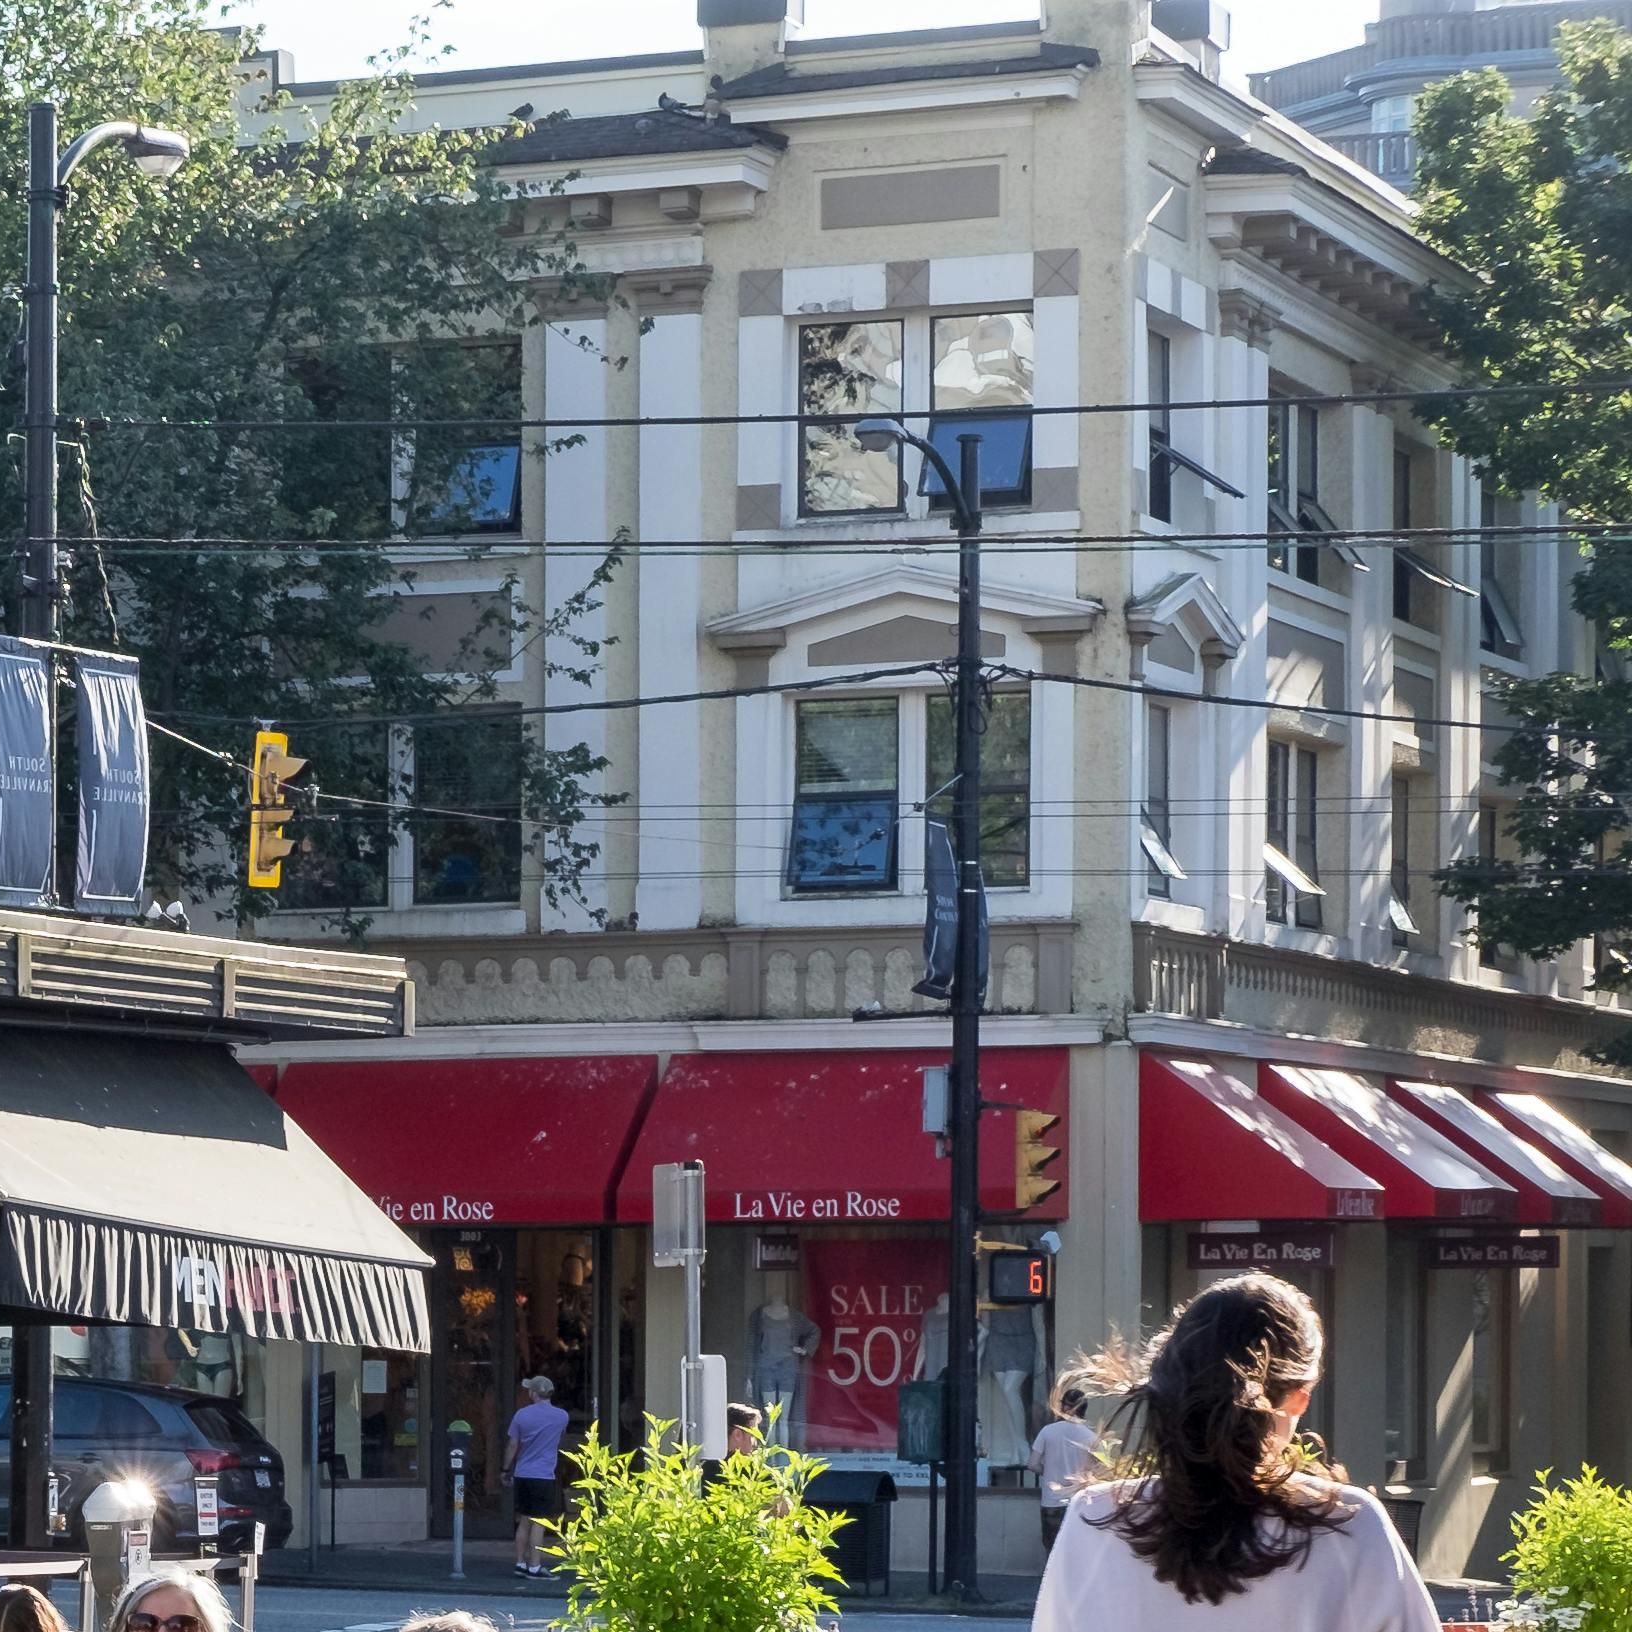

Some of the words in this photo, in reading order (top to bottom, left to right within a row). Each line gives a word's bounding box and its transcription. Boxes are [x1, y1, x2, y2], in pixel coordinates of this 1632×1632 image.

[410, 1201, 435, 1221] en
[442, 1195, 494, 1221] Rose
[734, 1192, 764, 1218] La
[768, 1192, 805, 1218] Vie
[812, 1198, 838, 1218] en
[846, 1191, 901, 1217] Rose
[1199, 1243, 1221, 1260] La
[1221, 1243, 1248, 1260] Vie
[1252, 1243, 1277, 1260] En
[1282, 1242, 1322, 1261] Rose
[1029, 1260, 1043, 1294] 6
[831, 1285, 924, 1315] SALE
